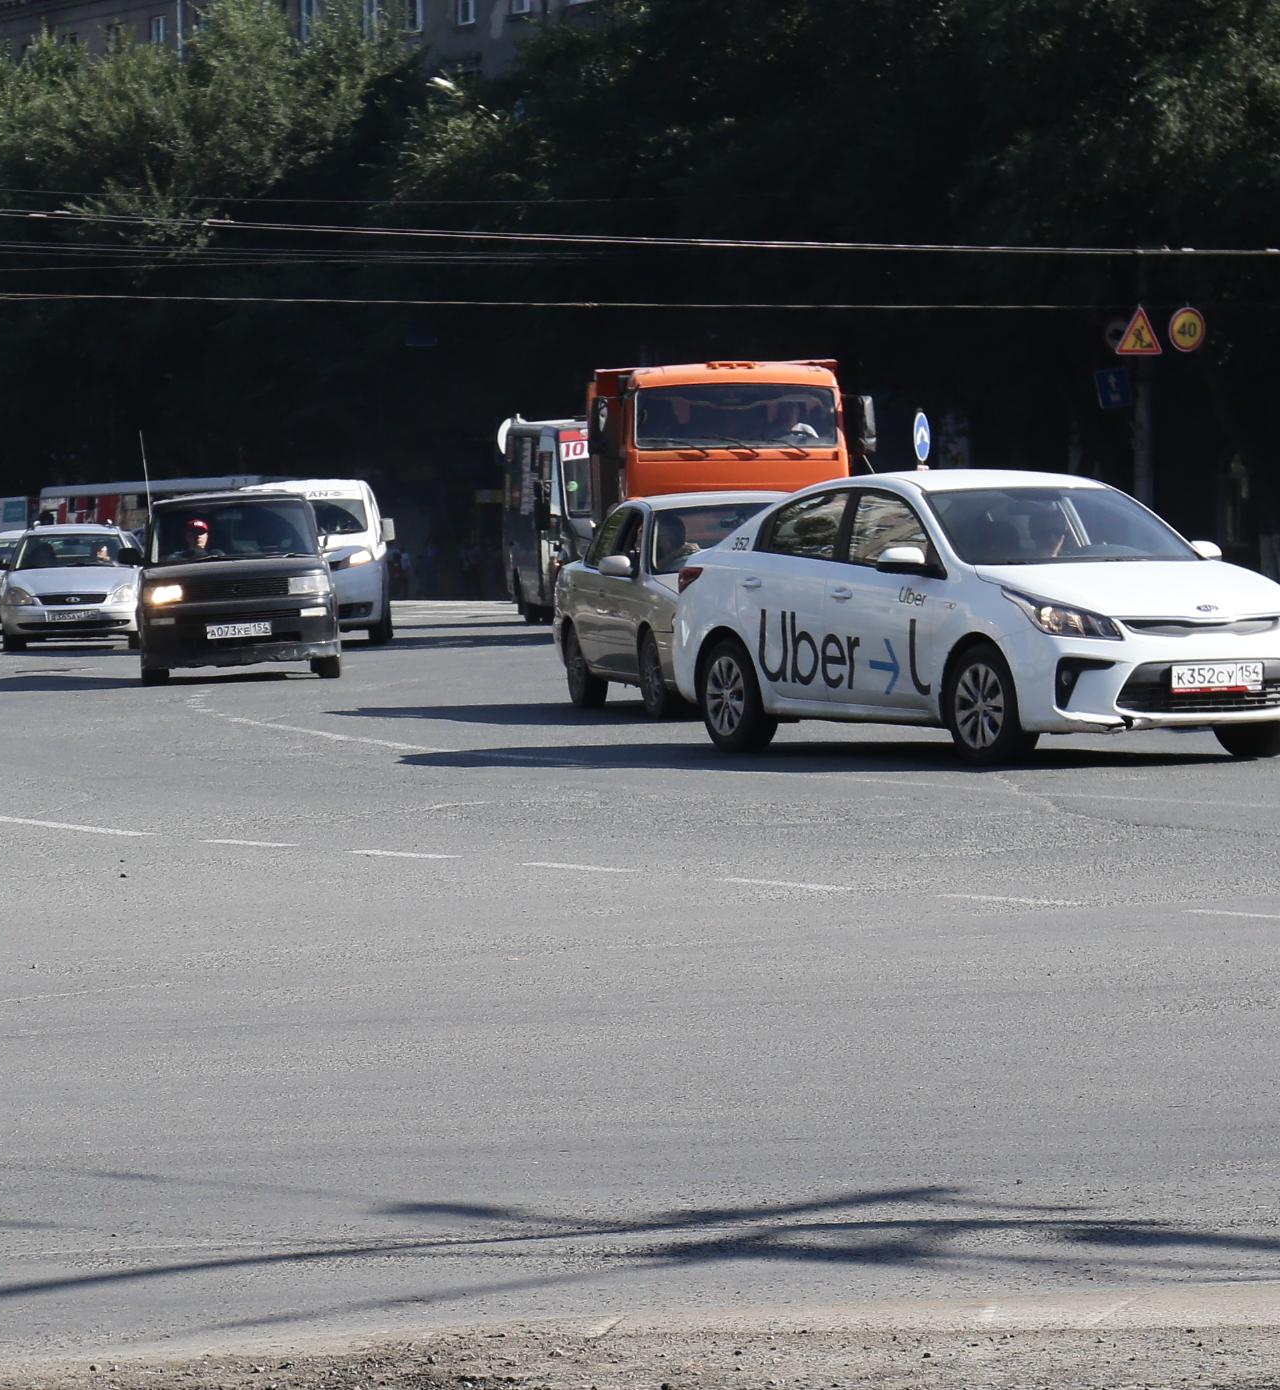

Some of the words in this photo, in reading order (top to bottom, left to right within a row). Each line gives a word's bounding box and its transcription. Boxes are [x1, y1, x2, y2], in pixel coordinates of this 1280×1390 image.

[1177, 322, 1197, 338] 40
[731, 537, 750, 551] 352
[898, 586, 927, 607] Uber
[758, 608, 861, 690] Uber
[1176, 667, 1235, 686] К352СУ
[1238, 665, 1260, 678] 154
